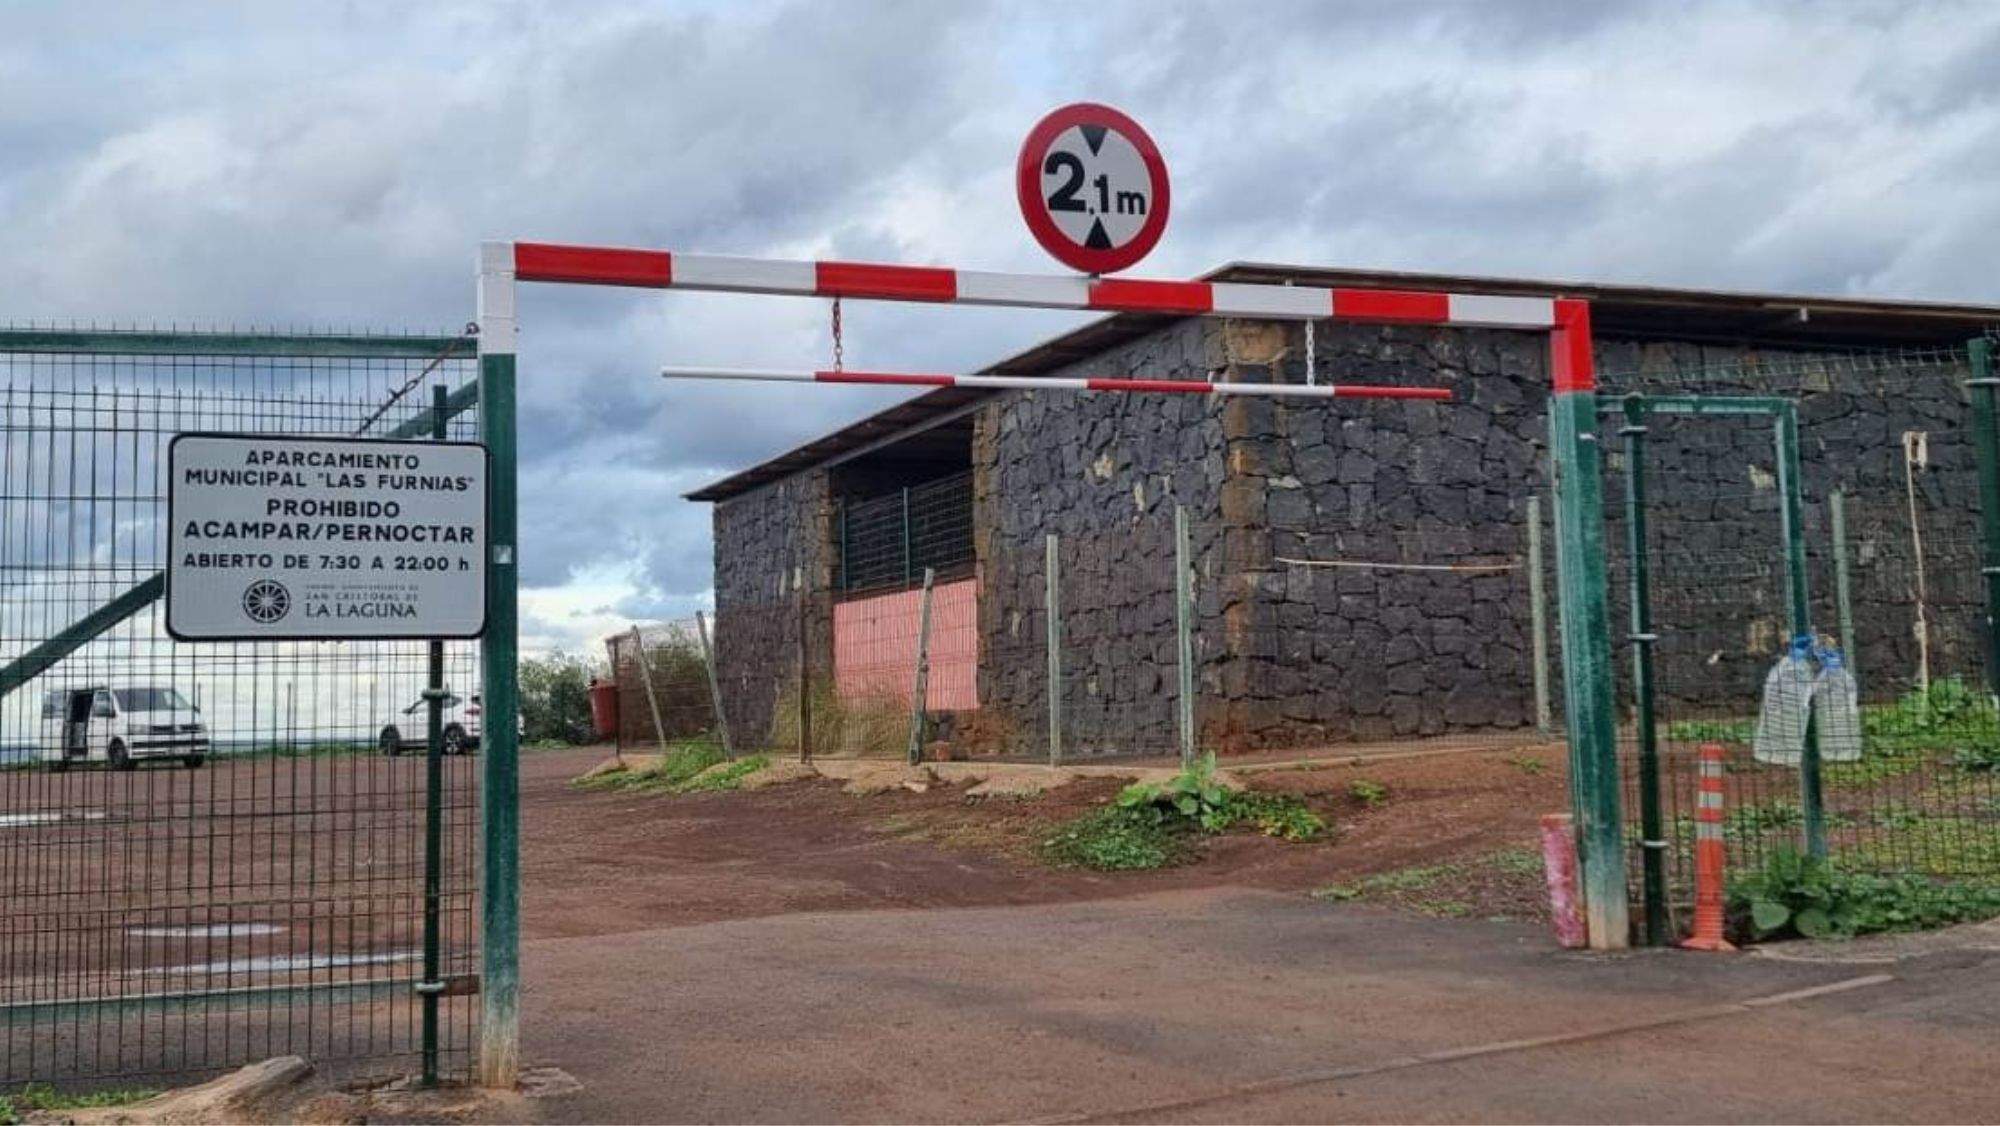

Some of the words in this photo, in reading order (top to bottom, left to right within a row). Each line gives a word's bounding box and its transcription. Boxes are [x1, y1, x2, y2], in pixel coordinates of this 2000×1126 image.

[245, 450, 420, 470] APARCAMIENTO
[185, 469, 307, 488] MUNICIPAL
[317, 473, 367, 489] "LAS
[378, 474, 475, 491] FURNIAS"
[266, 499, 400, 518] PROHIBIDO
[184, 521, 475, 543] ACAMPAR/PERNOCTAR
[184, 553, 273, 569] ABIERTO
[284, 554, 309, 569] DE
[320, 555, 360, 570] 7:30
[371, 556, 384, 570] A
[394, 556, 449, 571] 22:00
[459, 556, 469, 571] h
[306, 602, 331, 618] LA
[336, 602, 418, 618] LAGUNA
